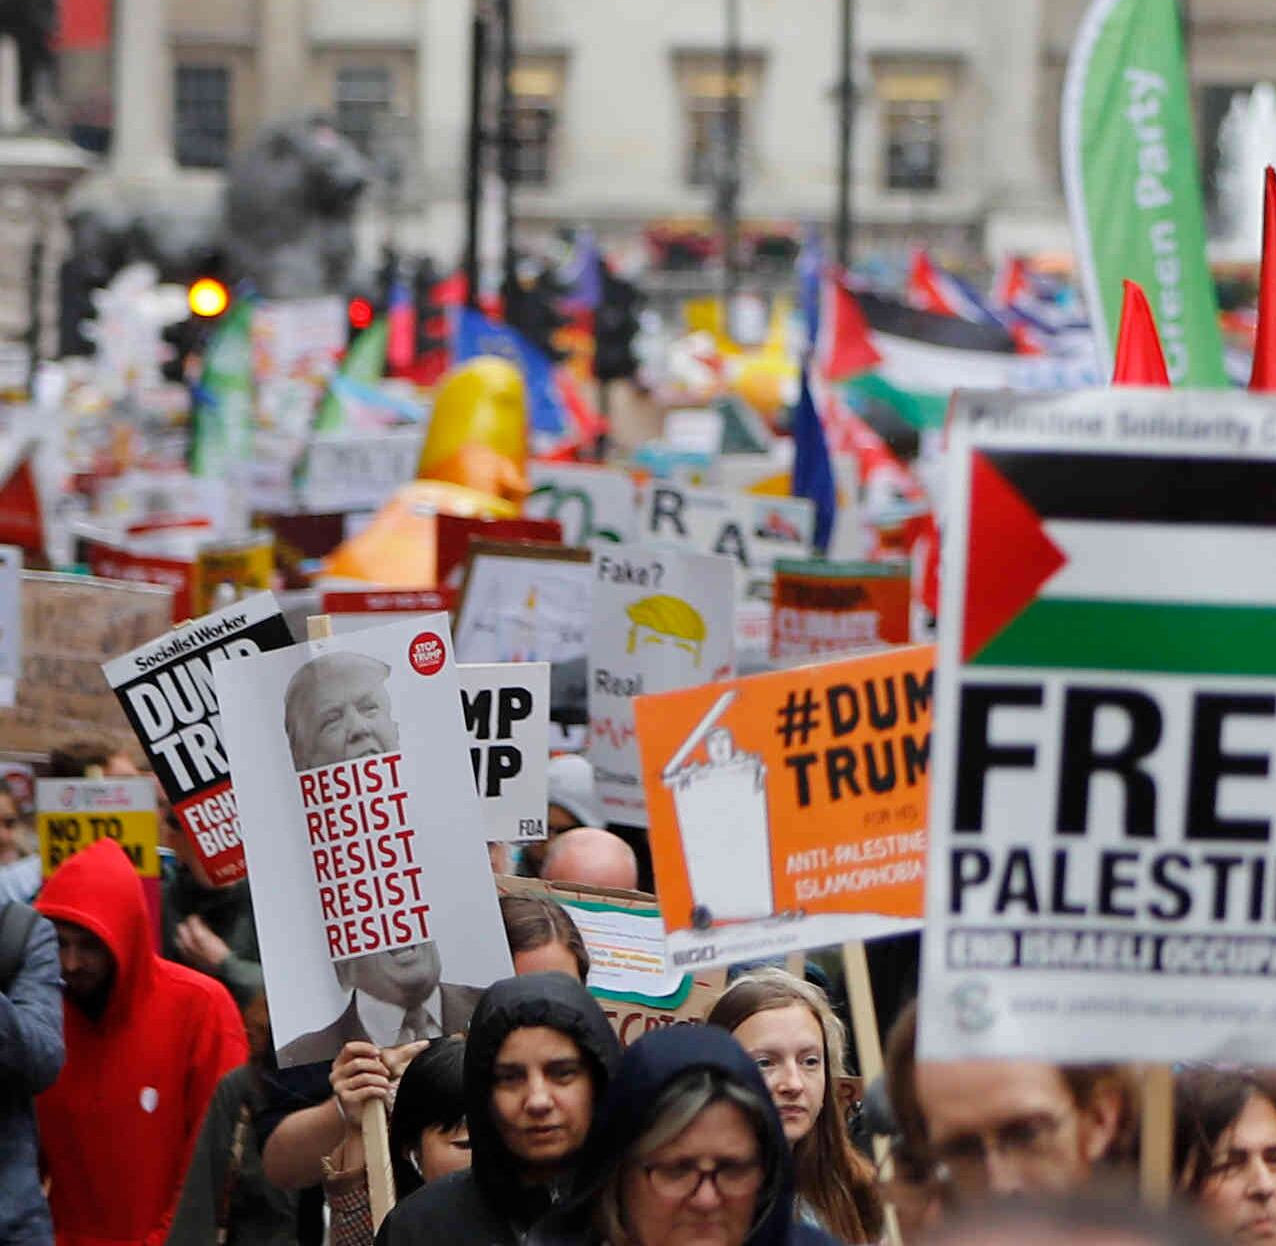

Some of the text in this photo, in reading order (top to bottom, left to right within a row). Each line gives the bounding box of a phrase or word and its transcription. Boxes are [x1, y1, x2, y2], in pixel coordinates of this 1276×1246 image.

[1123, 65, 1173, 209] Party
[967, 407, 1103, 436] Palestine
[1113, 411, 1250, 447] Solidarity
[597, 557, 665, 587] Fake?
[135, 614, 248, 672] Socialist Worker
[299, 754, 402, 808] RESIST
[48, 819, 81, 842] NO
[184, 791, 238, 833] FIGH
[306, 792, 408, 846] RESIST
[312, 830, 416, 883] RESIST
[319, 867, 423, 920] RESIST
[326, 905, 430, 958] RESIST
[962, 932, 1012, 967] END
[1021, 935, 1150, 970] ISRAELI
